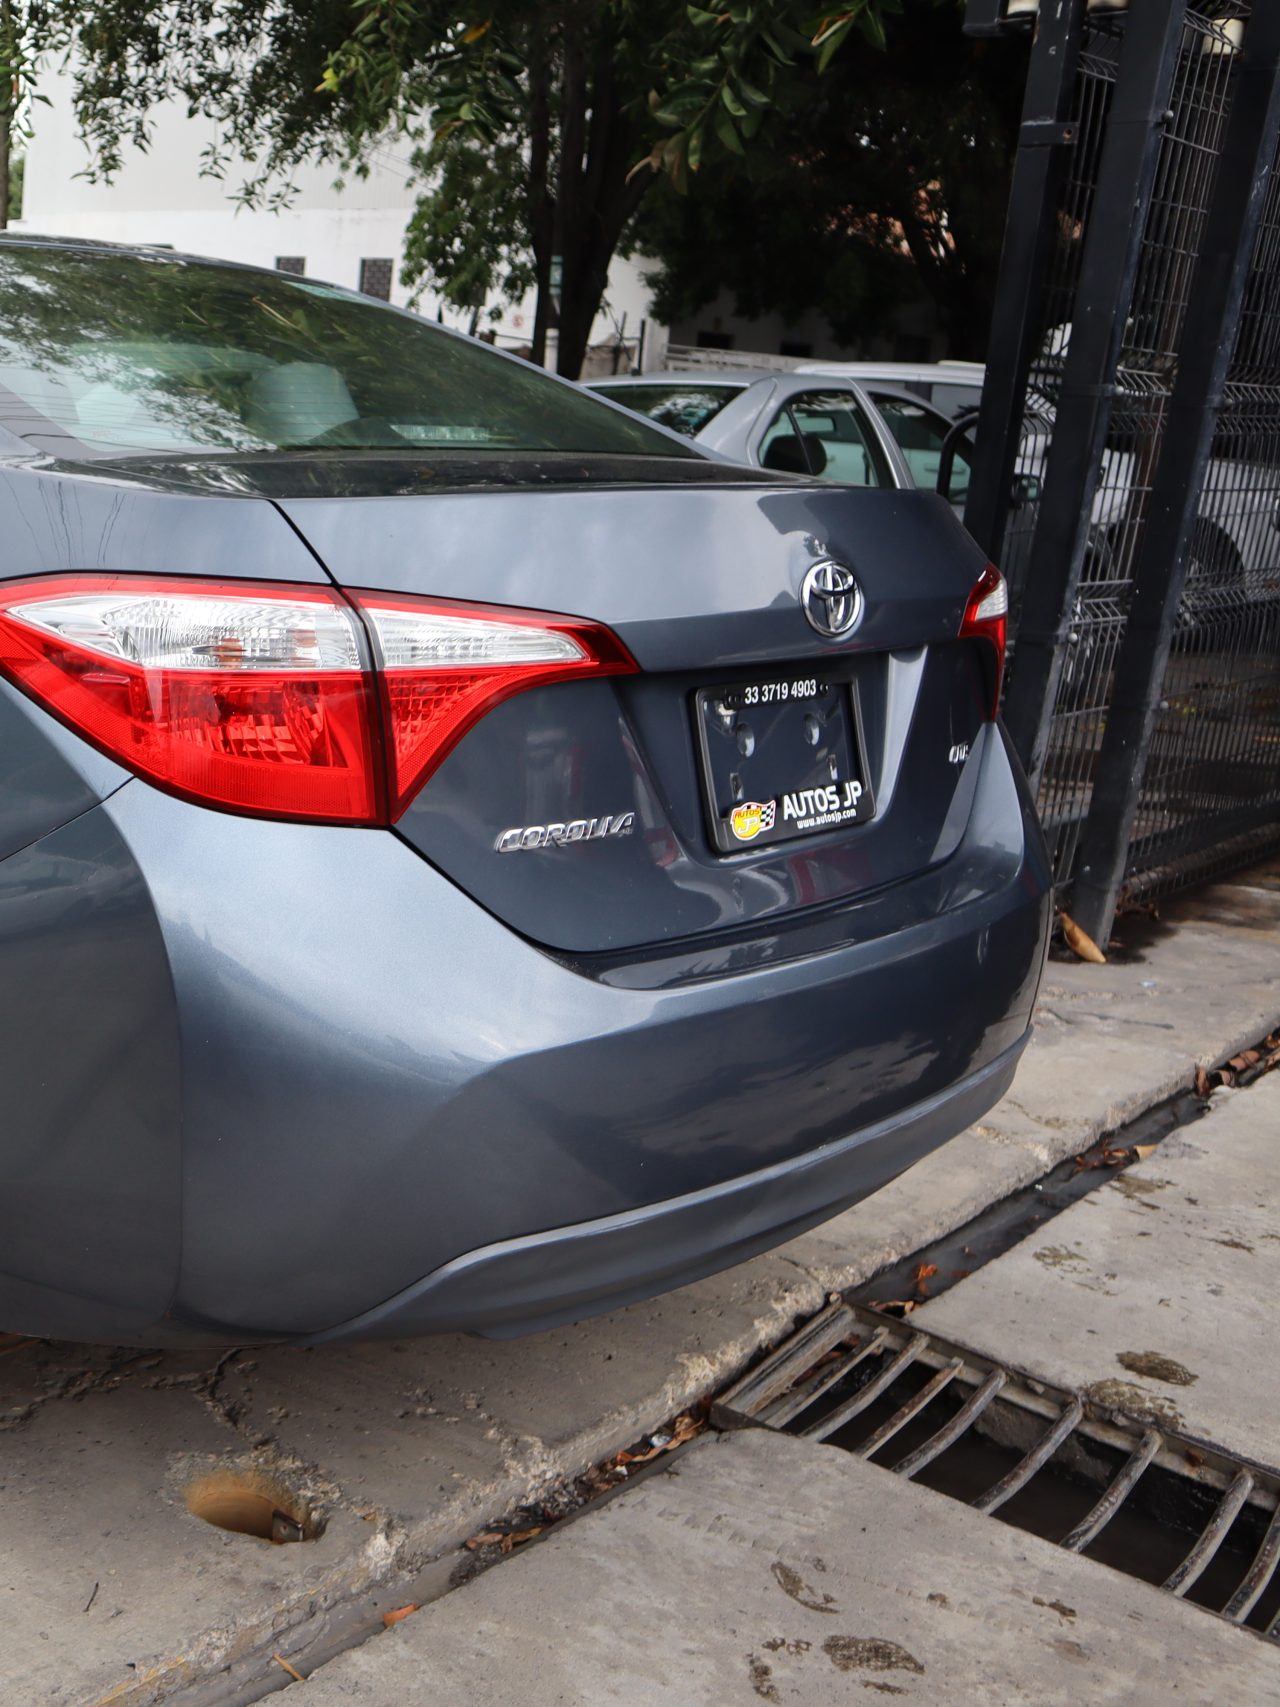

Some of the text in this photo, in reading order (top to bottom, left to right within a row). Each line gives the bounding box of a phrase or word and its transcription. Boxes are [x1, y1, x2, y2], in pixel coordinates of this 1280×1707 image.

[744, 679, 817, 704] 33 3719 4903
[783, 780, 863, 820] AUTOS JP
[734, 809, 760, 819] AUTOS
[737, 816, 759, 835] JP
[796, 808, 857, 830] www.autosjp.com
[494, 812, 635, 853] COROLLA
